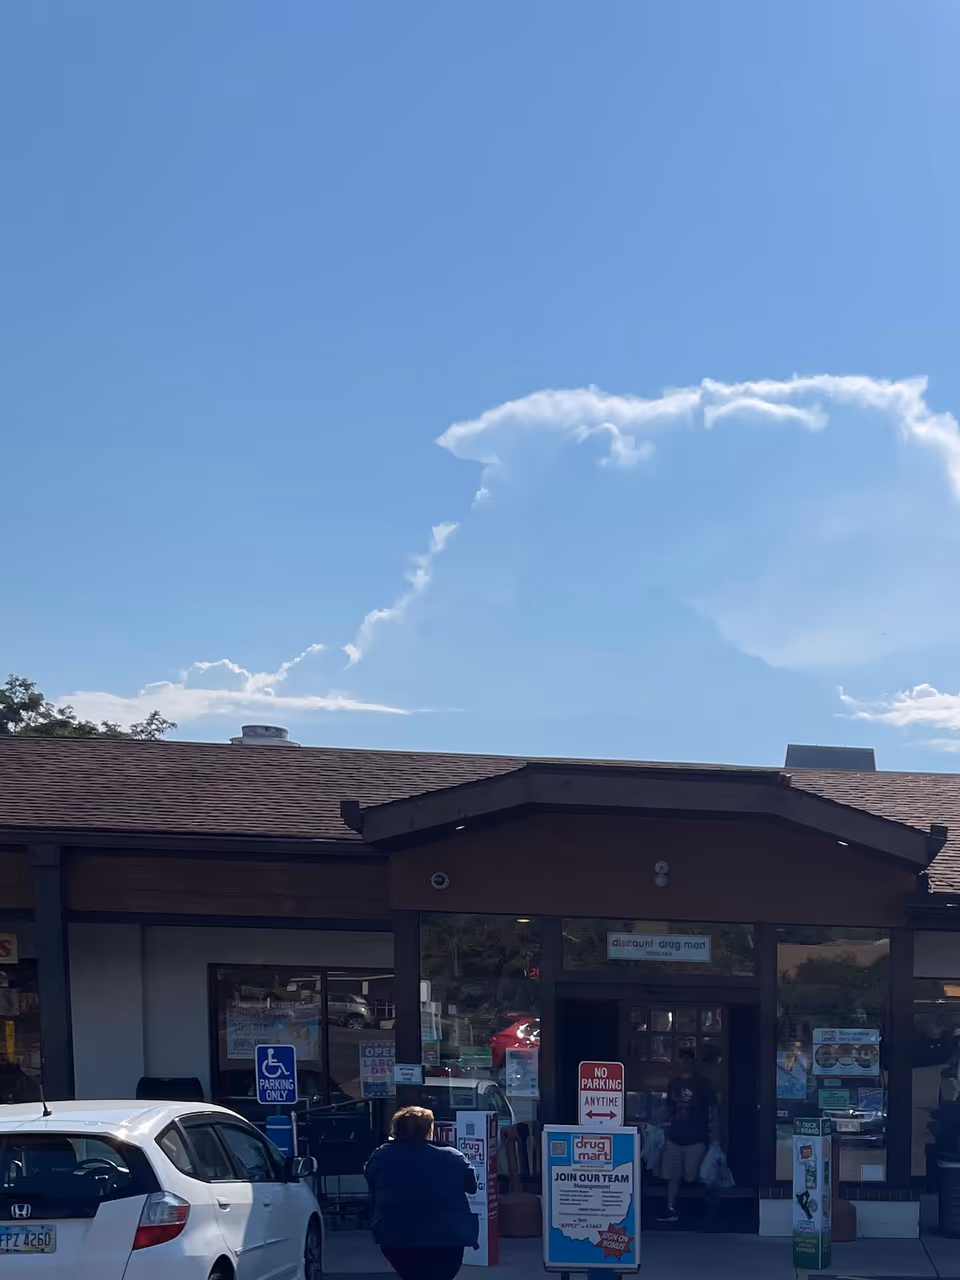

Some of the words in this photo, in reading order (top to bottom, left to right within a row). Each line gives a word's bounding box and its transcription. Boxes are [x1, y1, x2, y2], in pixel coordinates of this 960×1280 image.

[659, 939, 681, 951] drug
[594, 1067, 608, 1078] NO
[259, 1079, 294, 1090] PARKING
[581, 1078, 622, 1090] PARKING
[266, 1090, 289, 1101] ONLY
[584, 1096, 619, 1107] ANYTIME
[460, 1137, 480, 1153] drug
[576, 1136, 606, 1153] drug
[578, 1151, 611, 1161] mart
[555, 1172, 577, 1182] JOIN
[579, 1173, 600, 1183] OUR
[602, 1174, 630, 1183] TEAM
[24, 1232, 51, 1247] 4260
[618, 1234, 629, 1242] ON
[602, 1239, 626, 1251] BONUS
